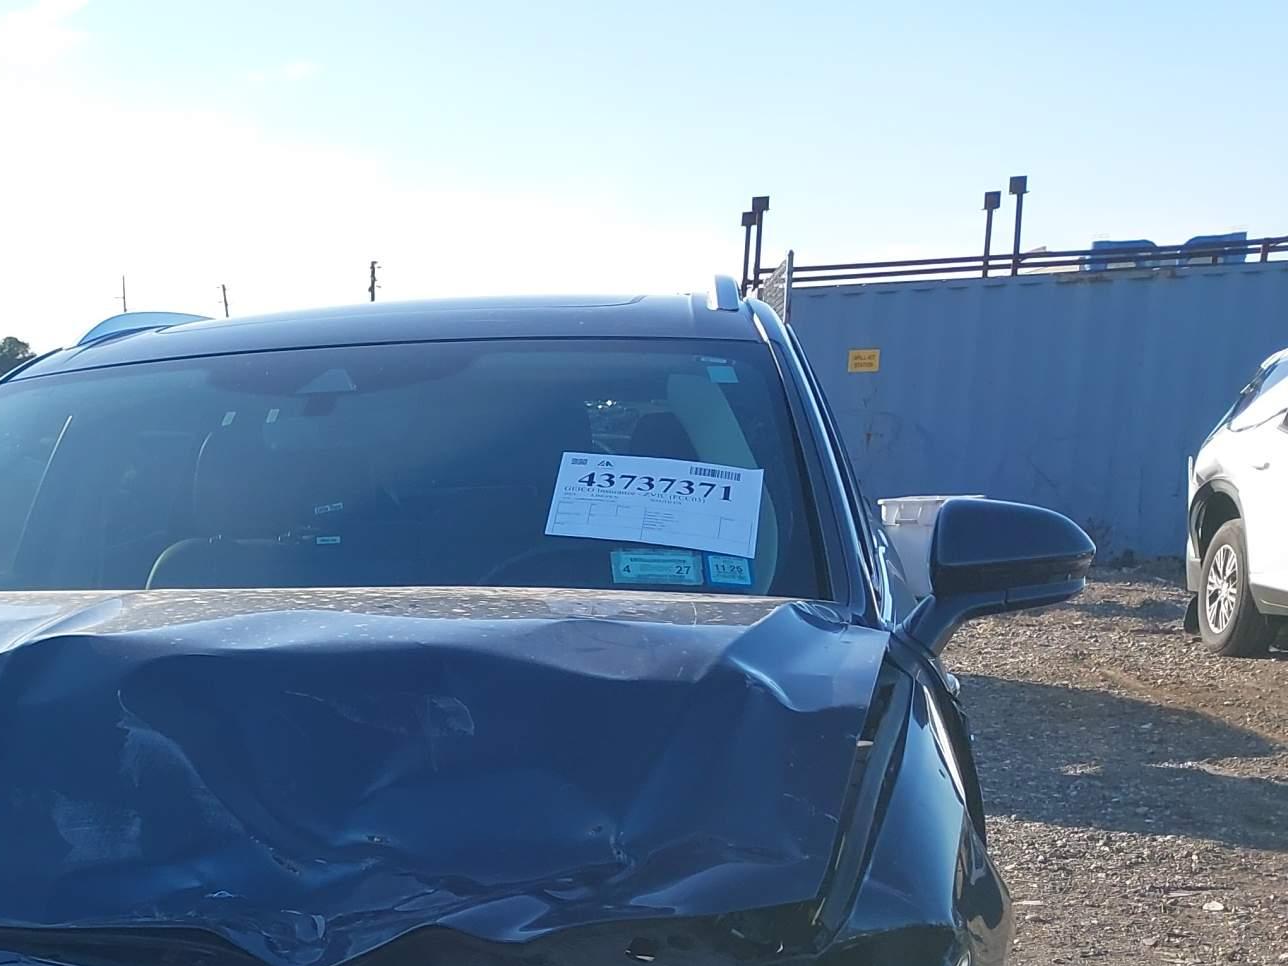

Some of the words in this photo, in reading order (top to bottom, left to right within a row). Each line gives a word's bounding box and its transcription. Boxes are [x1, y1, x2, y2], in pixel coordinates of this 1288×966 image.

[577, 471, 732, 502] 43737371
[623, 564, 631, 574] 4
[675, 564, 691, 575] 27
